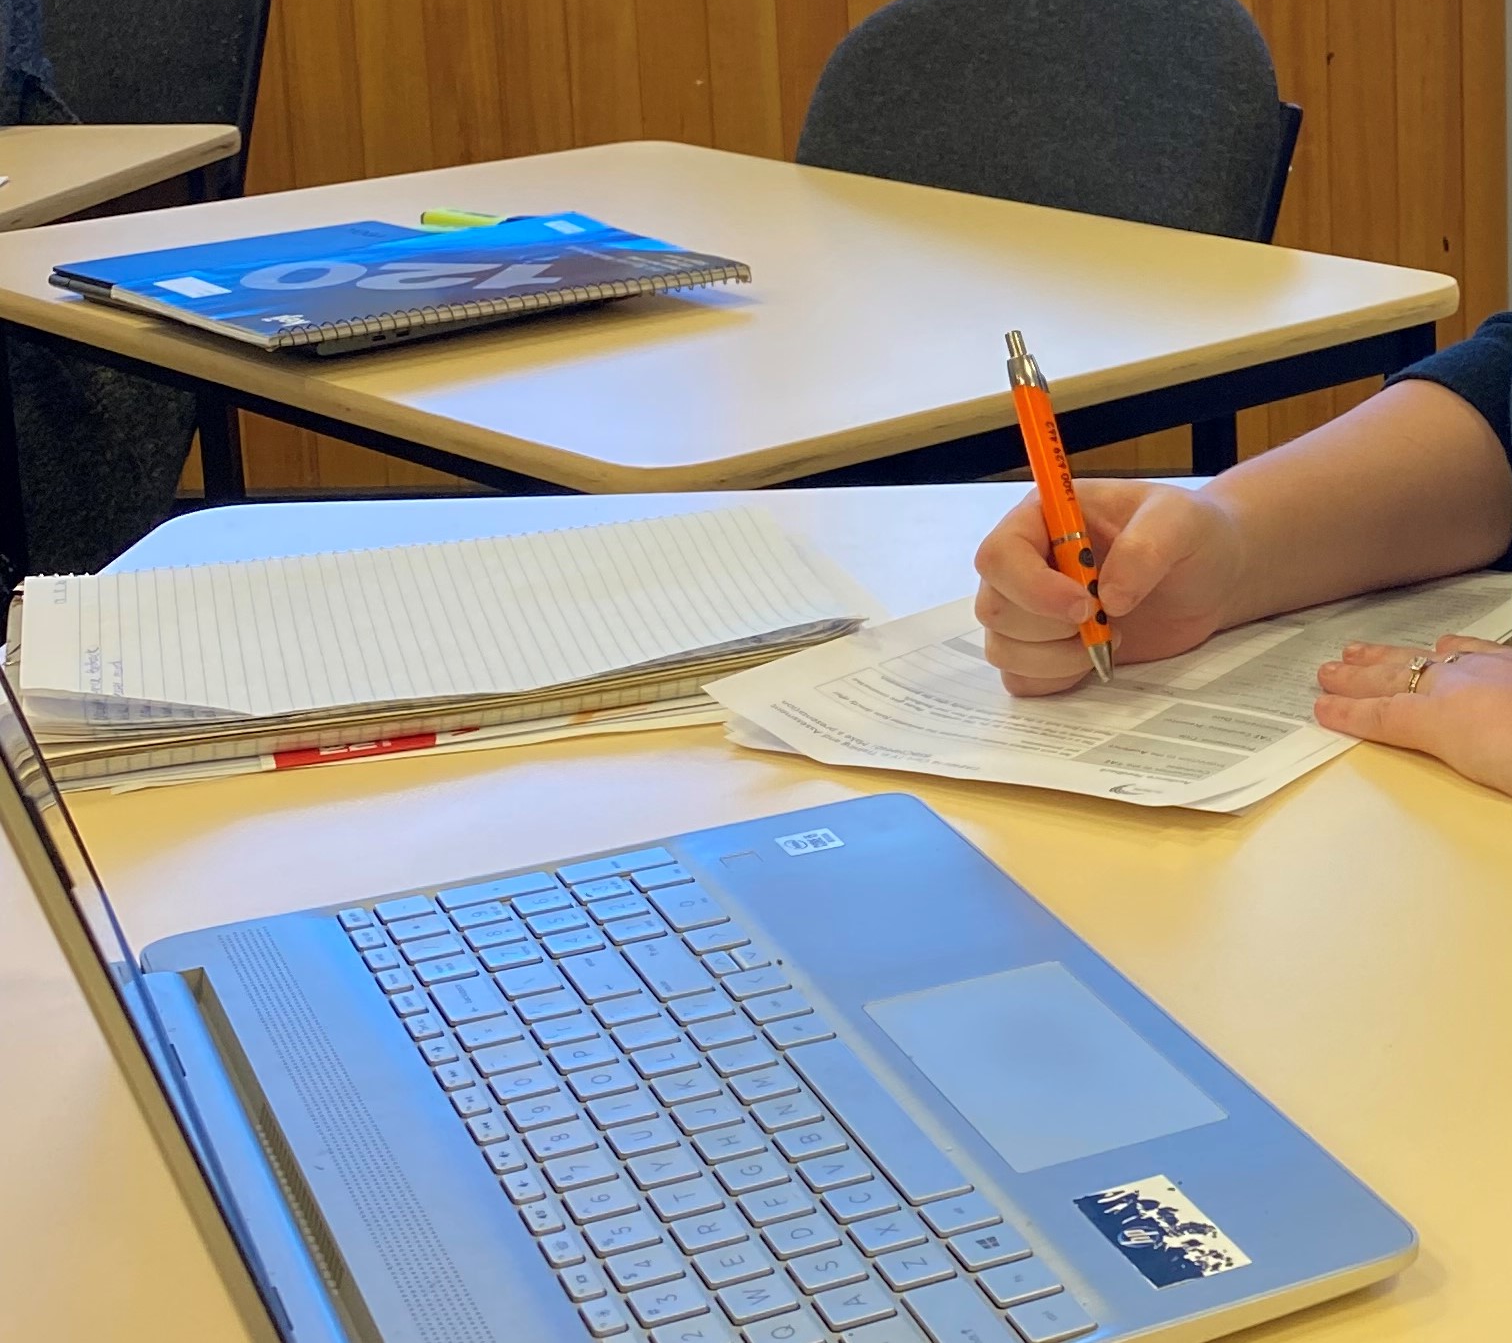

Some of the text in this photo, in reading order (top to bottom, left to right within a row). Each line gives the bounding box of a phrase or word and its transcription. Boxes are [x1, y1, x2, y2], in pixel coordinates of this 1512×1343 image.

[240, 259, 565, 290] 120
[1061, 473, 1075, 501] 1300
[608, 903, 625, 911] 2
[679, 900, 695, 908] 0
[471, 910, 488, 919] 9
[486, 930, 503, 938] 8
[563, 934, 578, 943] 4
[572, 1050, 594, 1059] P
[655, 1053, 676, 1062] L
[590, 1074, 612, 1085] O
[674, 1079, 697, 1090] K
[629, 1130, 653, 1141] U
[717, 1134, 742, 1147] H
[650, 1161, 673, 1172] Y
[739, 1164, 763, 1176] G
[751, 1075, 928, 1270] Z X C V B N M
[672, 1192, 696, 1202] T
[763, 1197, 788, 1208] F
[514, 1078, 704, 1341] 2 3 4 5 6 7 8 9 0
[697, 1222, 720, 1235] R
[790, 1227, 814, 1239] D
[1120, 1228, 1160, 1246] hp
[720, 1254, 745, 1267] E
[815, 1260, 839, 1273] S
[742, 1288, 771, 1306] W
[842, 1294, 868, 1306] A
[770, 1324, 795, 1340] Q
